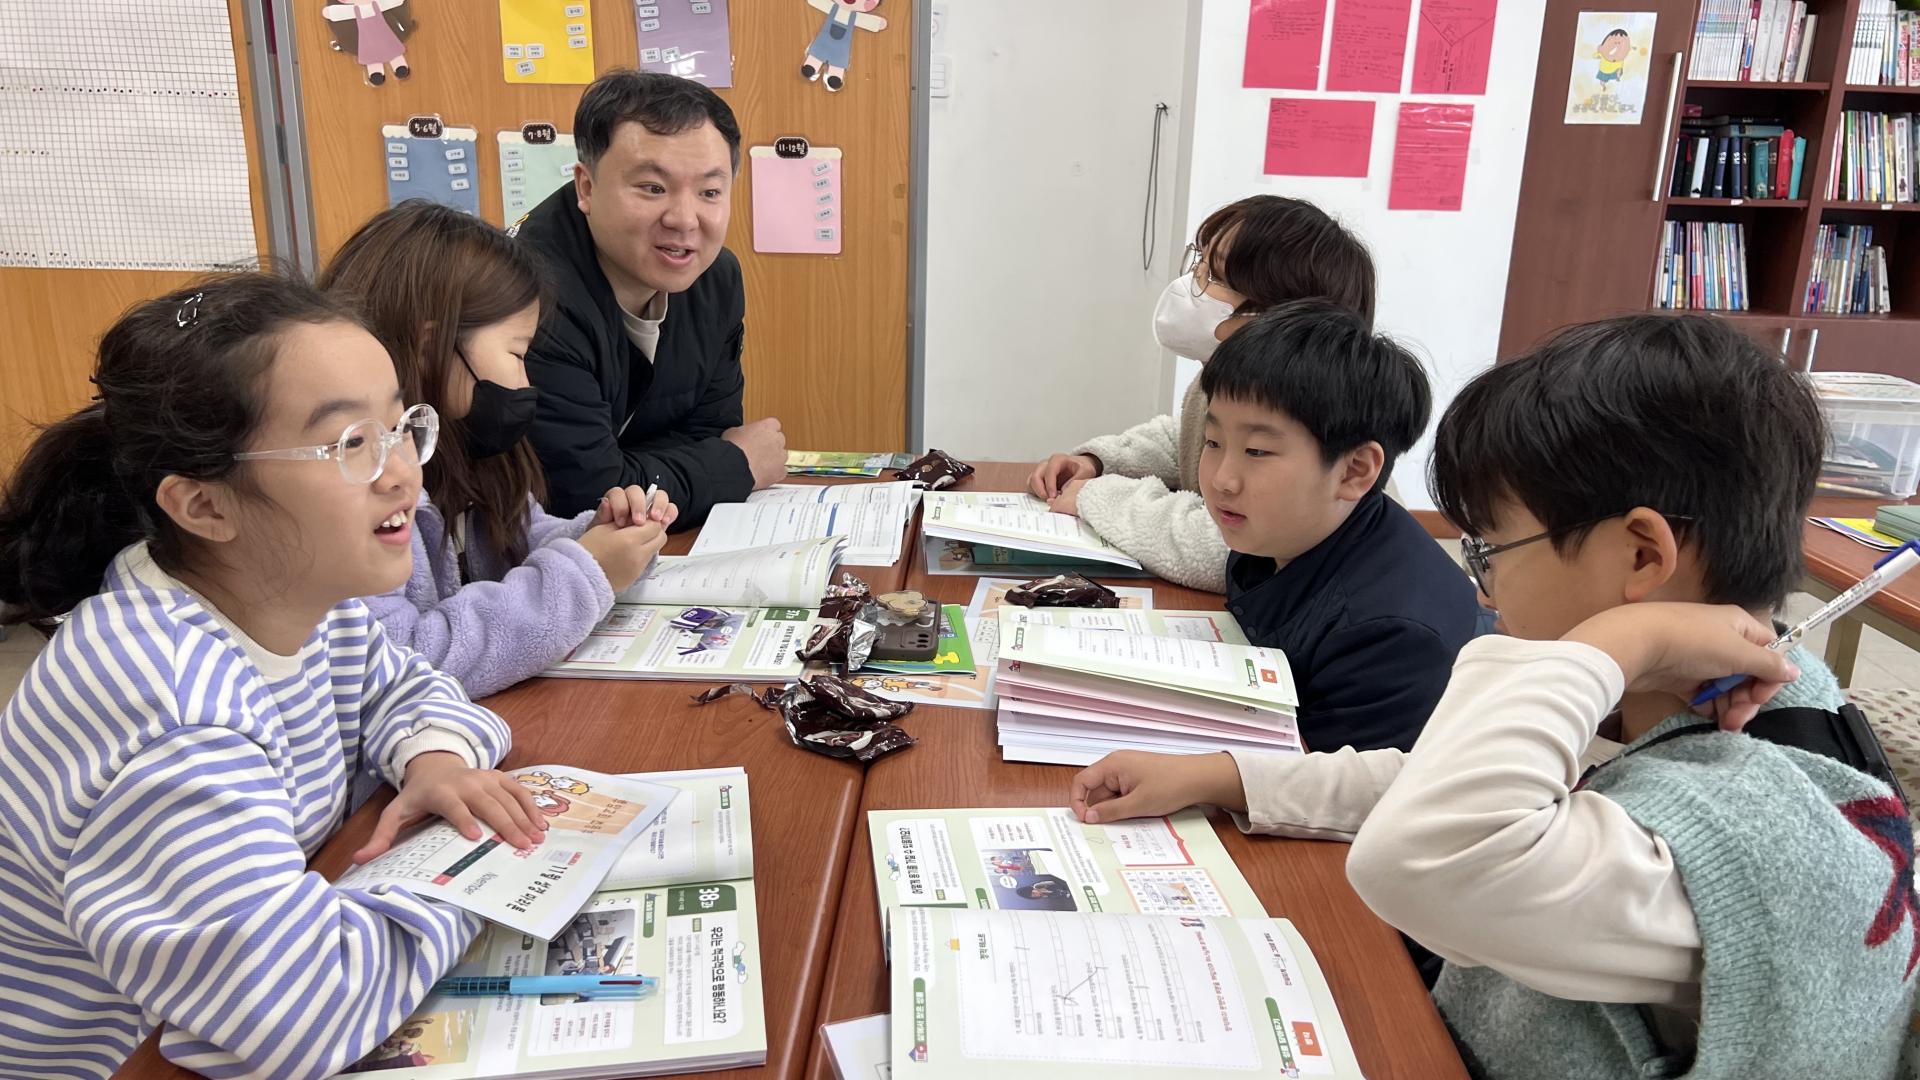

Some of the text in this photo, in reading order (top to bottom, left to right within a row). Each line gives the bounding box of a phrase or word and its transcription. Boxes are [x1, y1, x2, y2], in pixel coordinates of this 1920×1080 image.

[463, 871, 499, 896] November
[906, 864, 920, 879] 용기를
[505, 865, 568, 913] 11월 성경 마라톤
[698, 886, 720, 909] 38과
[710, 926, 728, 1024] 우리는 적극적으로 행동하나요?
